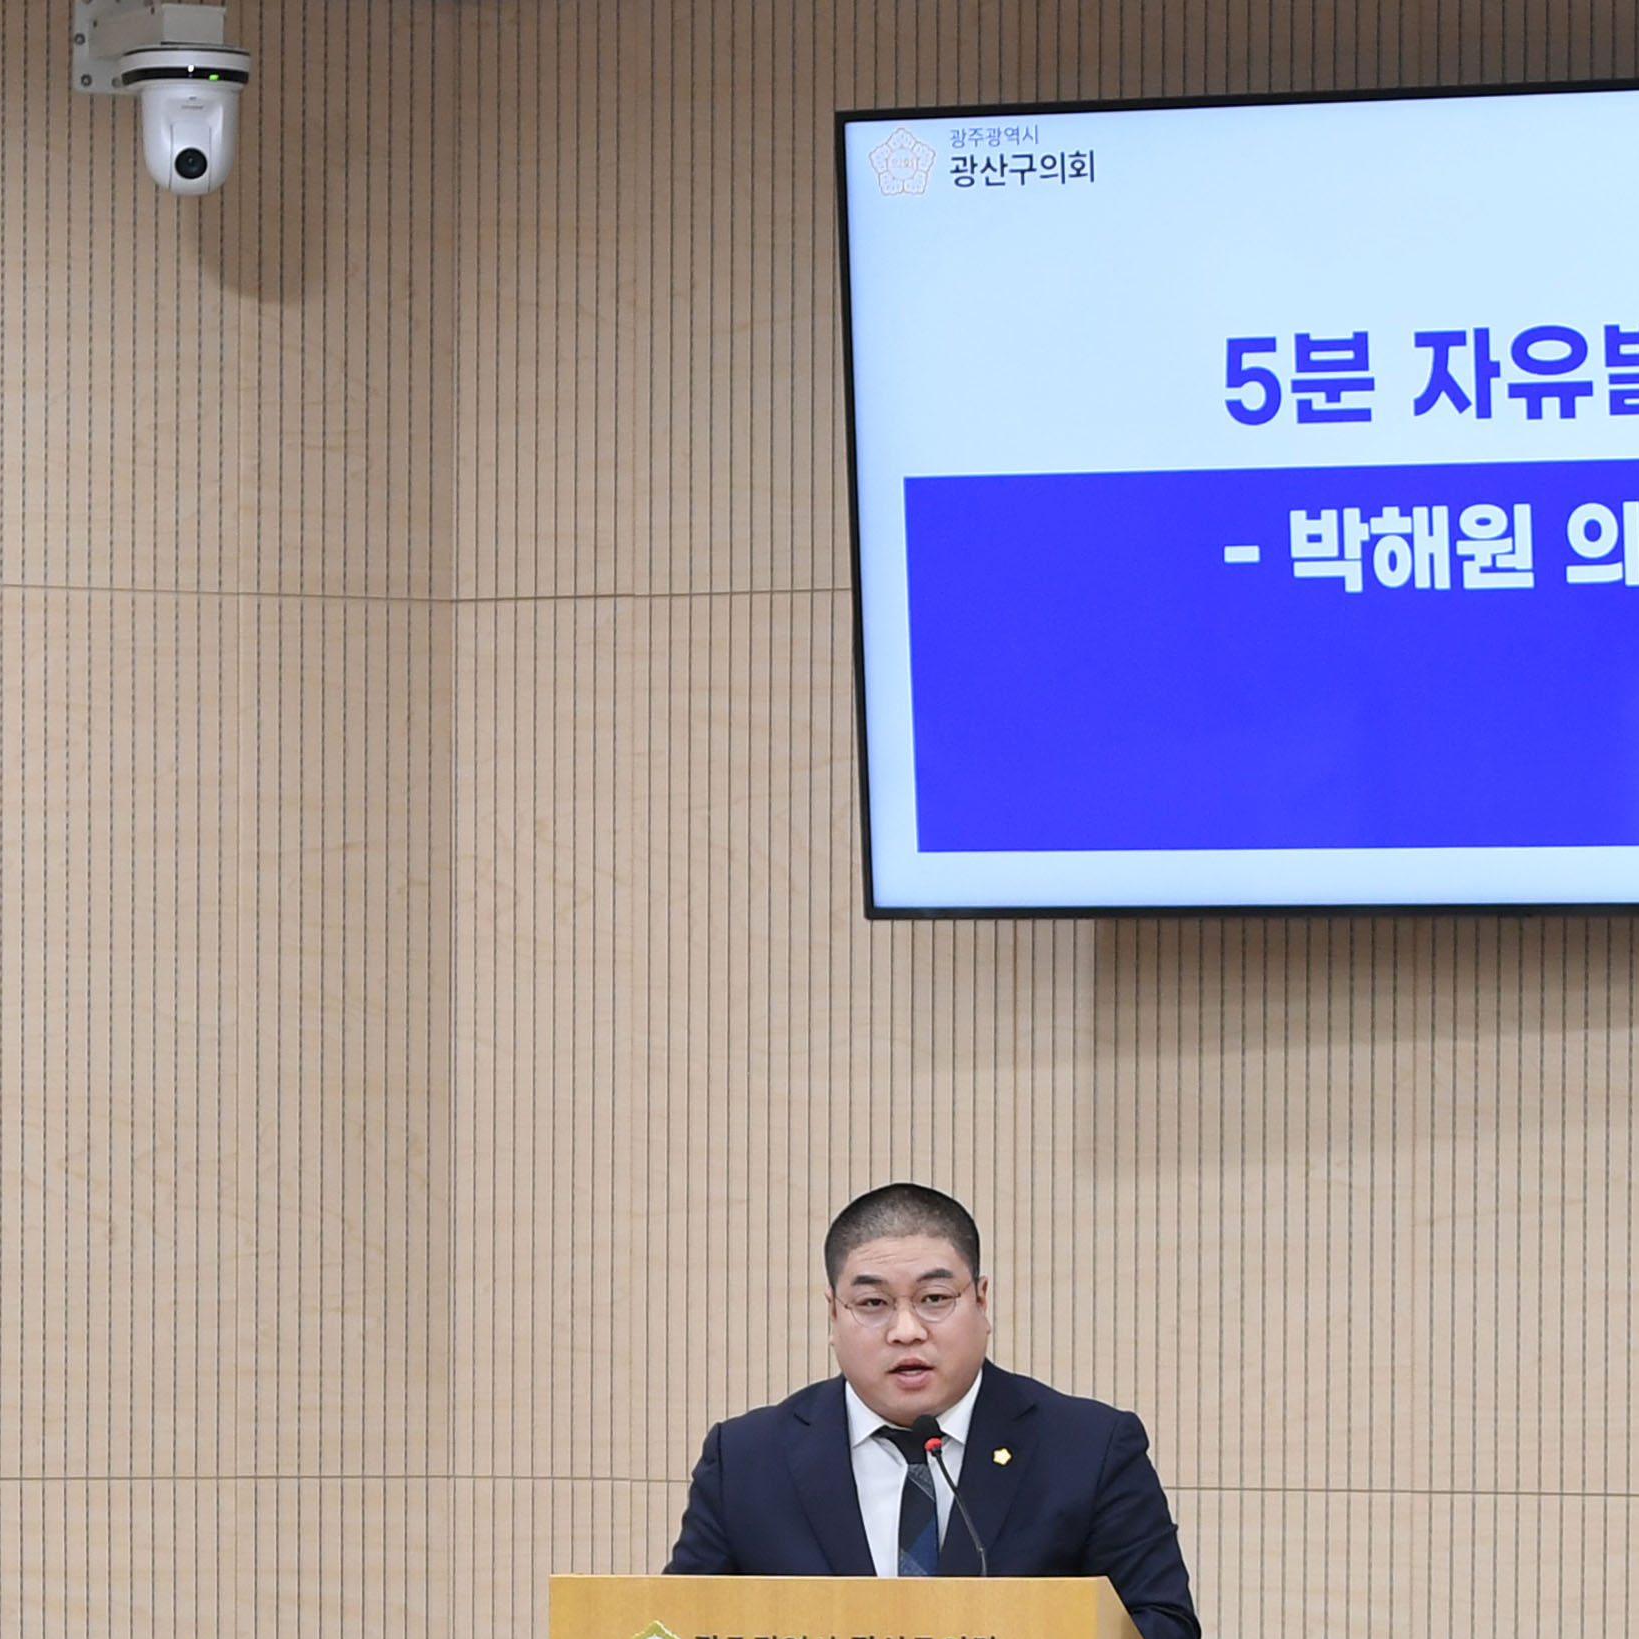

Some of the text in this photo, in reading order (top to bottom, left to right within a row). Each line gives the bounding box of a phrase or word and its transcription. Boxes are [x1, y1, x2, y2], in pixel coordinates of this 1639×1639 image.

[949, 124, 1040, 149] 광주광역시
[949, 150, 1095, 188] 광산구의회
[1224, 330, 1375, 426] 5분
[1289, 503, 1535, 593] 박해원
